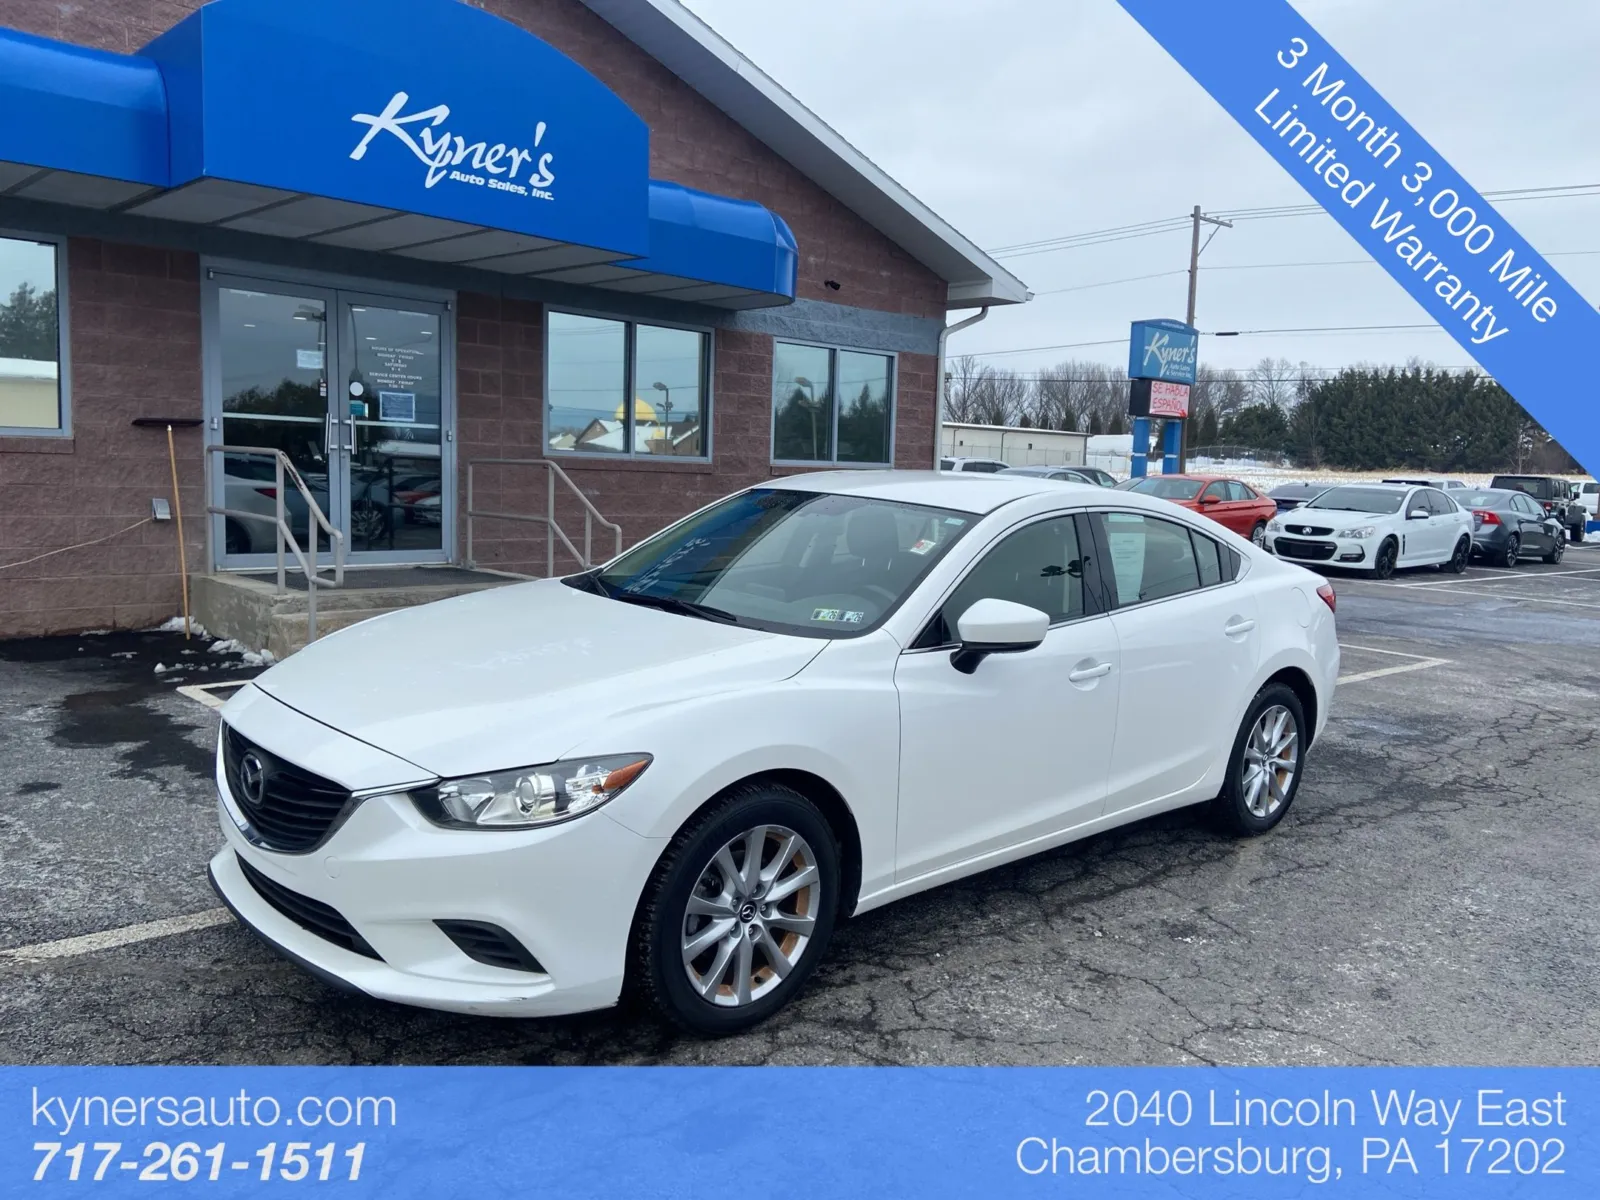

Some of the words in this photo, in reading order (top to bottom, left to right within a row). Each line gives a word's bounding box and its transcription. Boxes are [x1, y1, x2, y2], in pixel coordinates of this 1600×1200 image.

[350, 91, 556, 189] Kyner's
[449, 170, 485, 186] Auto
[488, 178, 529, 196] Sales,
[531, 187, 555, 201] Inc.
[1143, 332, 1196, 378] Kyner's
[1152, 382, 1163, 394] SE
[1164, 384, 1189, 397] HABLA
[1152, 397, 1184, 411] ESPAÑOL
